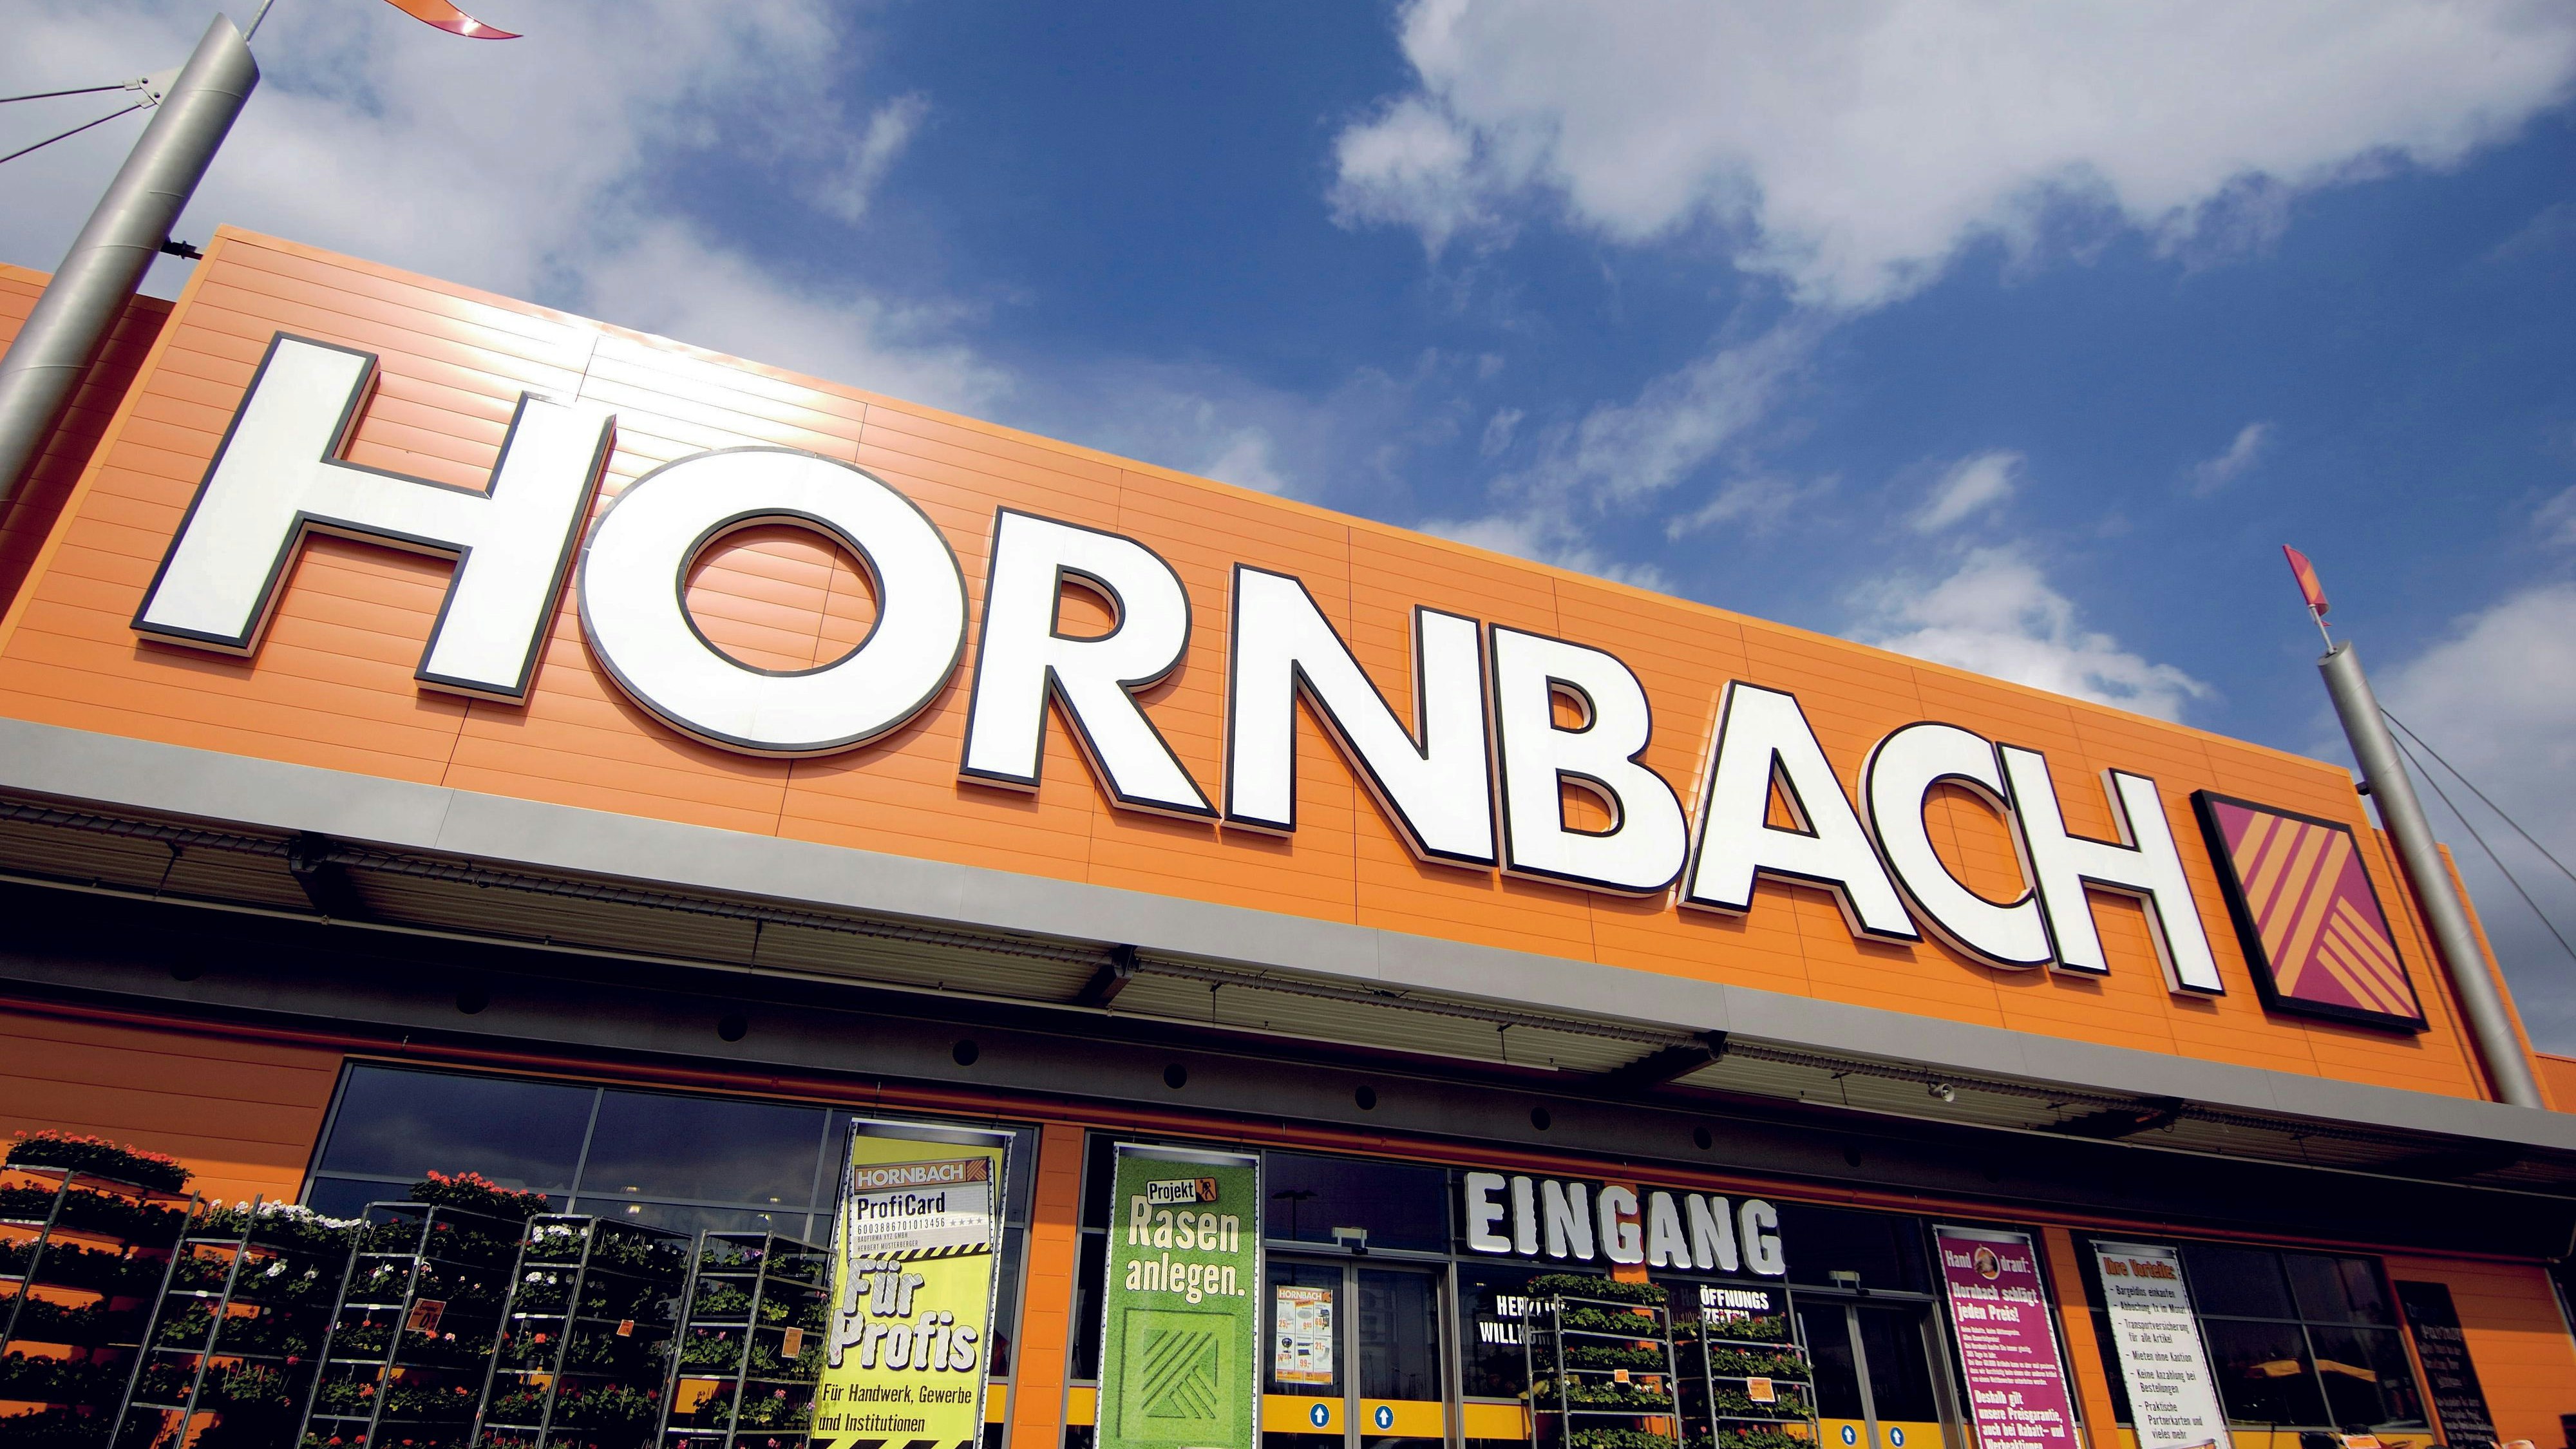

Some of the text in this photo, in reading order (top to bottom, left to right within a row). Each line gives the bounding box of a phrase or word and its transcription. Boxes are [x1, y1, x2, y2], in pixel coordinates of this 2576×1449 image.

[132, 330, 2226, 999] HORNBACH
[857, 1164, 963, 1187] HORNBACH
[1149, 1181, 1194, 1202] Projekt
[857, 1191, 945, 1220] ProfiCard
[1128, 1194, 1240, 1253] Rasen
[1464, 1171, 1786, 1275] EINGANG
[1945, 1250, 1973, 1269] Hand
[2103, 1256, 2128, 1276] Ihre
[842, 1258, 925, 1318] Für
[1125, 1251, 1245, 1305] anlegen.
[1279, 1290, 1322, 1301] HORNBACH
[1700, 1284, 1769, 1310] ÖFFNUNGS
[1951, 1282, 2000, 1301] Hornbach
[1956, 1302, 2020, 1323] jeden Preis!
[828, 1308, 979, 1372] Profis
[822, 1383, 972, 1405] Für Handwerk, Gewerbe
[1974, 1390, 2007, 1405] Deshalb
[1978, 1408, 2007, 1420] unsere
[2144, 1401, 2178, 1412] Praktische
[819, 1413, 925, 1432] und Institutionen
[1982, 1422, 2002, 1436] auch
[2002, 1423, 2016, 1437] bei
[2050, 1425, 2065, 1438] und
[2148, 1414, 2191, 1426] Partnerkarten
